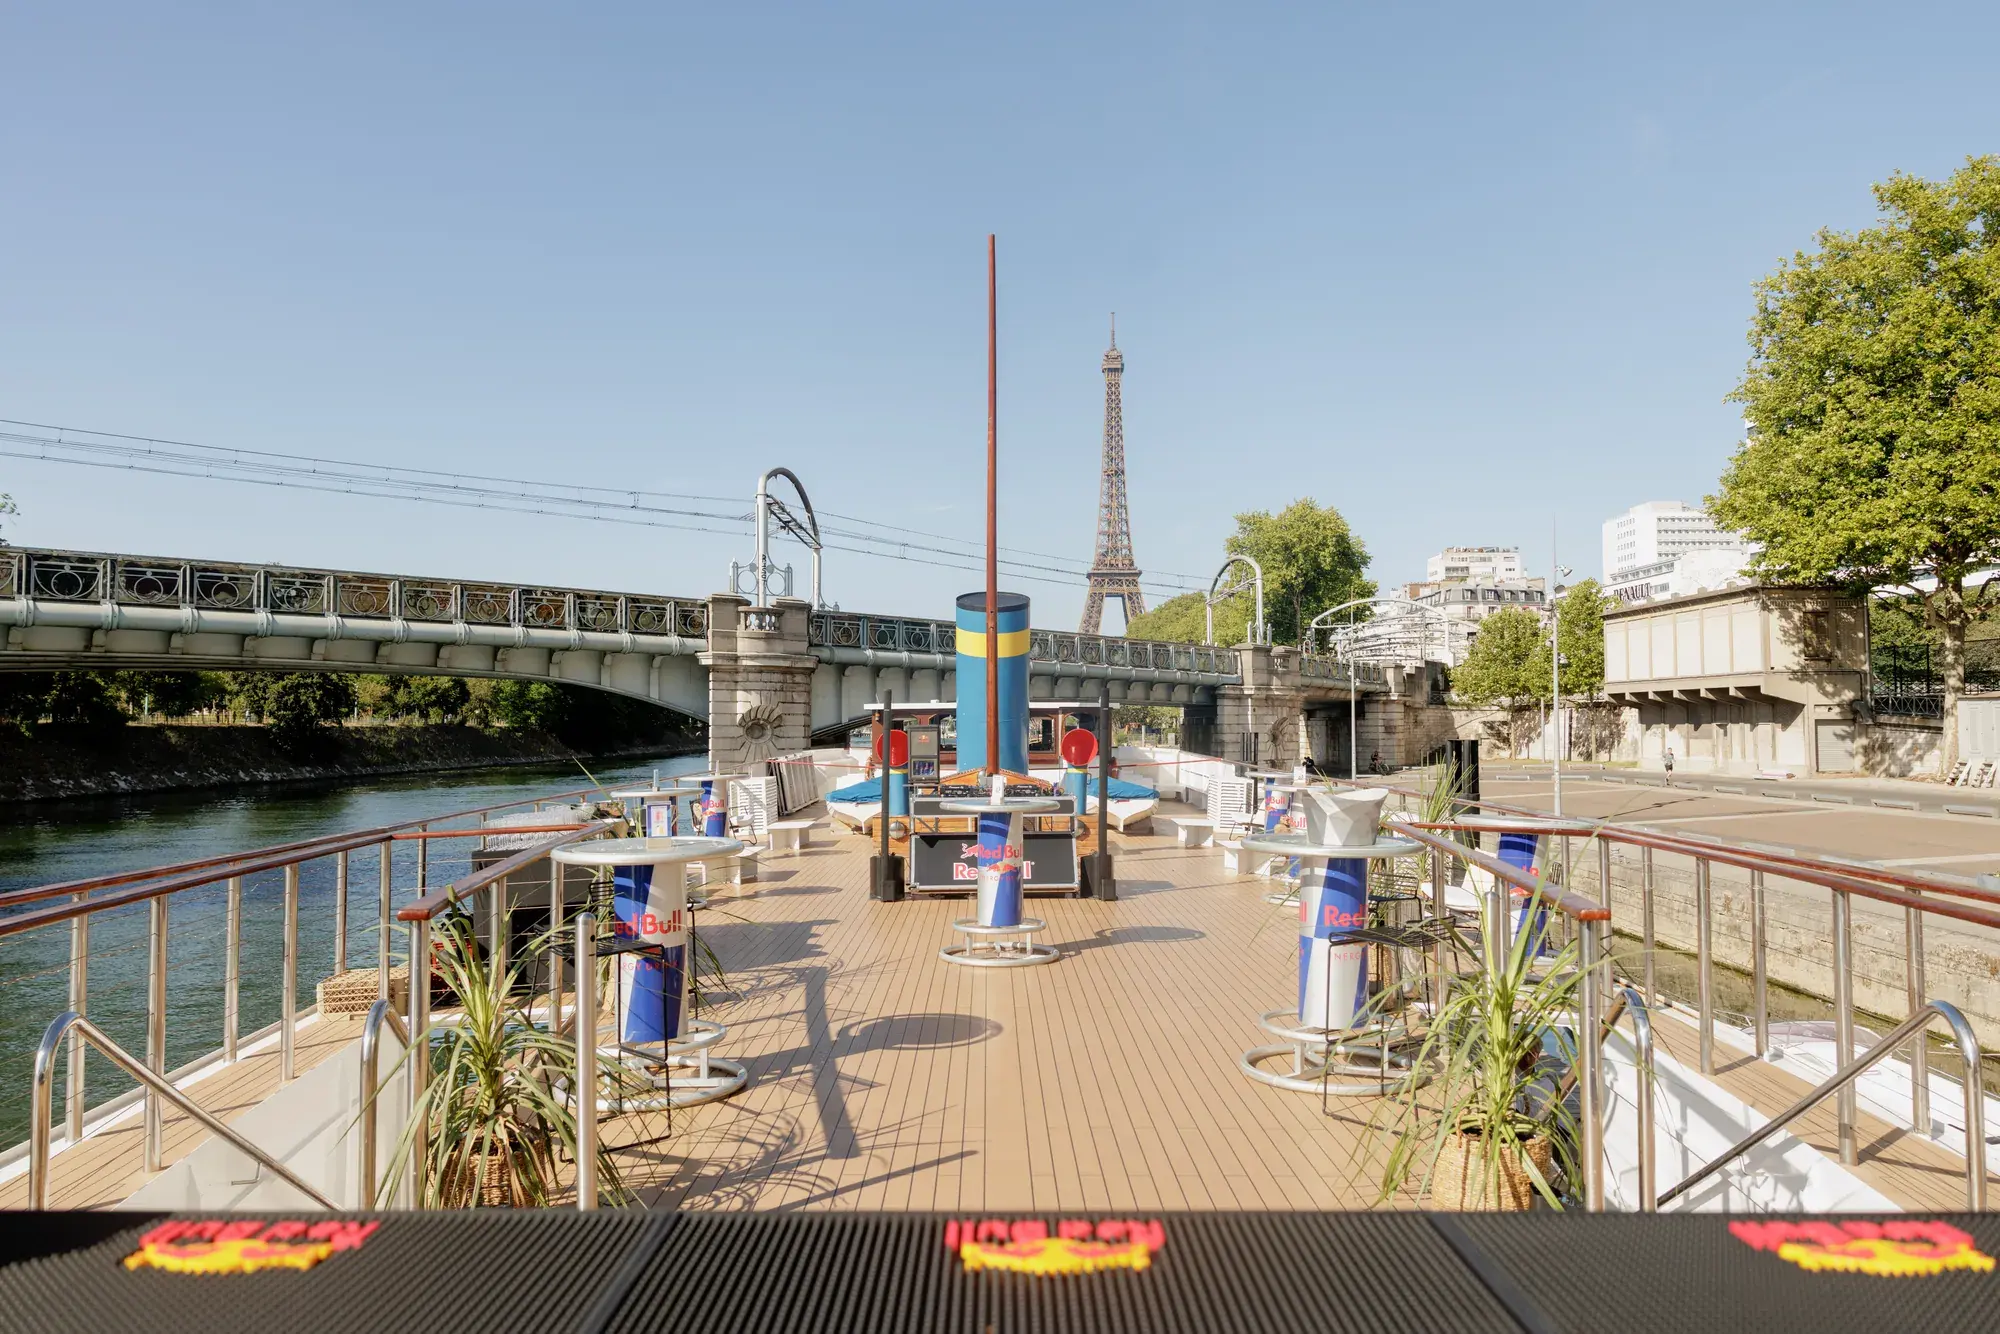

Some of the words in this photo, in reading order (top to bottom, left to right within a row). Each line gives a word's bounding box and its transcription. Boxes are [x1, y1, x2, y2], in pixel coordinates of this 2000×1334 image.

[979, 843, 1002, 859] Red
[1004, 843, 1022, 859] Bul
[953, 862, 978, 880] Re
[614, 912, 640, 937] ed
[642, 909, 682, 935] Bull
[1324, 904, 1364, 927] Red
